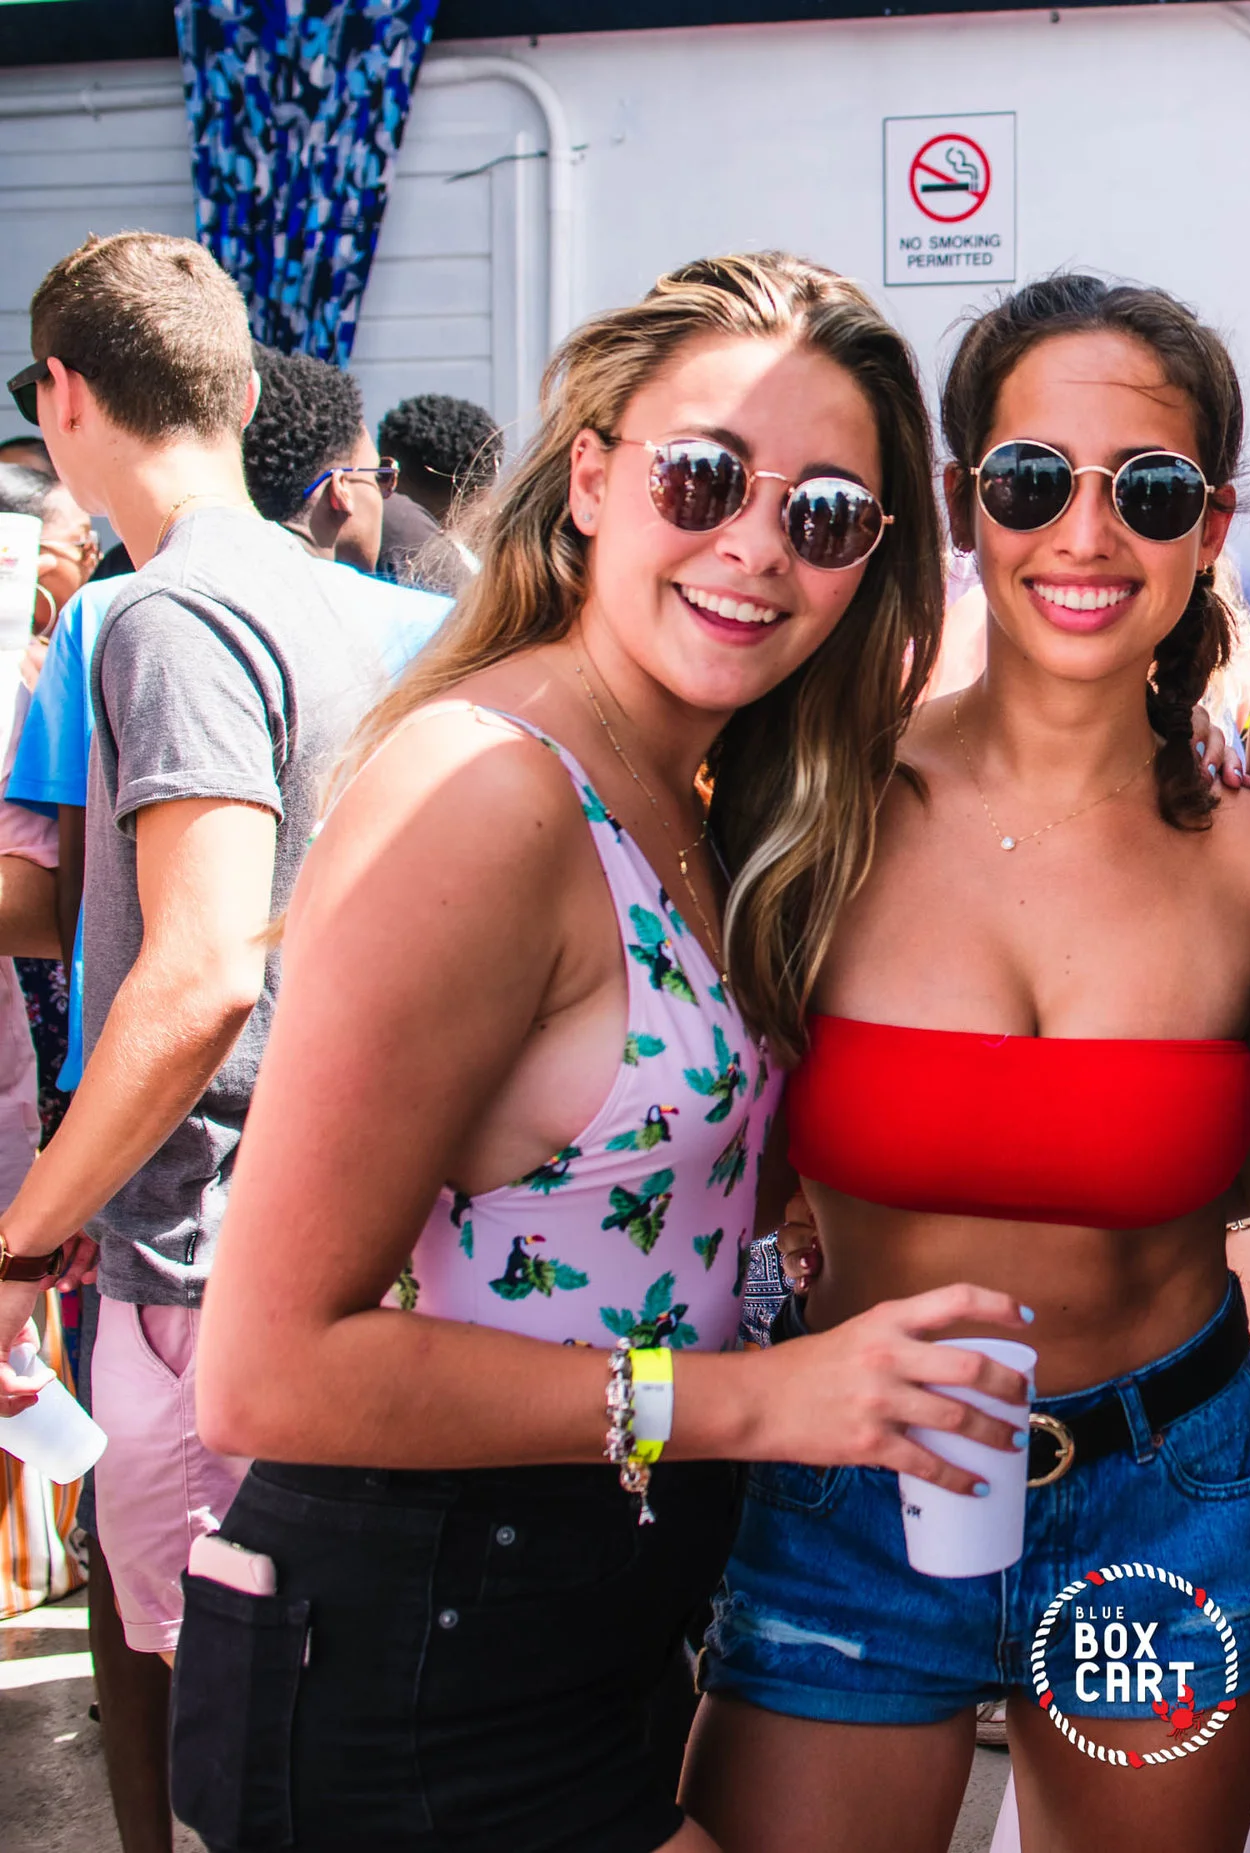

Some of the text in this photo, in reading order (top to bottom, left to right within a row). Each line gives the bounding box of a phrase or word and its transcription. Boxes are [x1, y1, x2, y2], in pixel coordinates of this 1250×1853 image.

[900, 234, 1001, 250] NO SMOKING
[907, 252, 992, 268] PERMITTED
